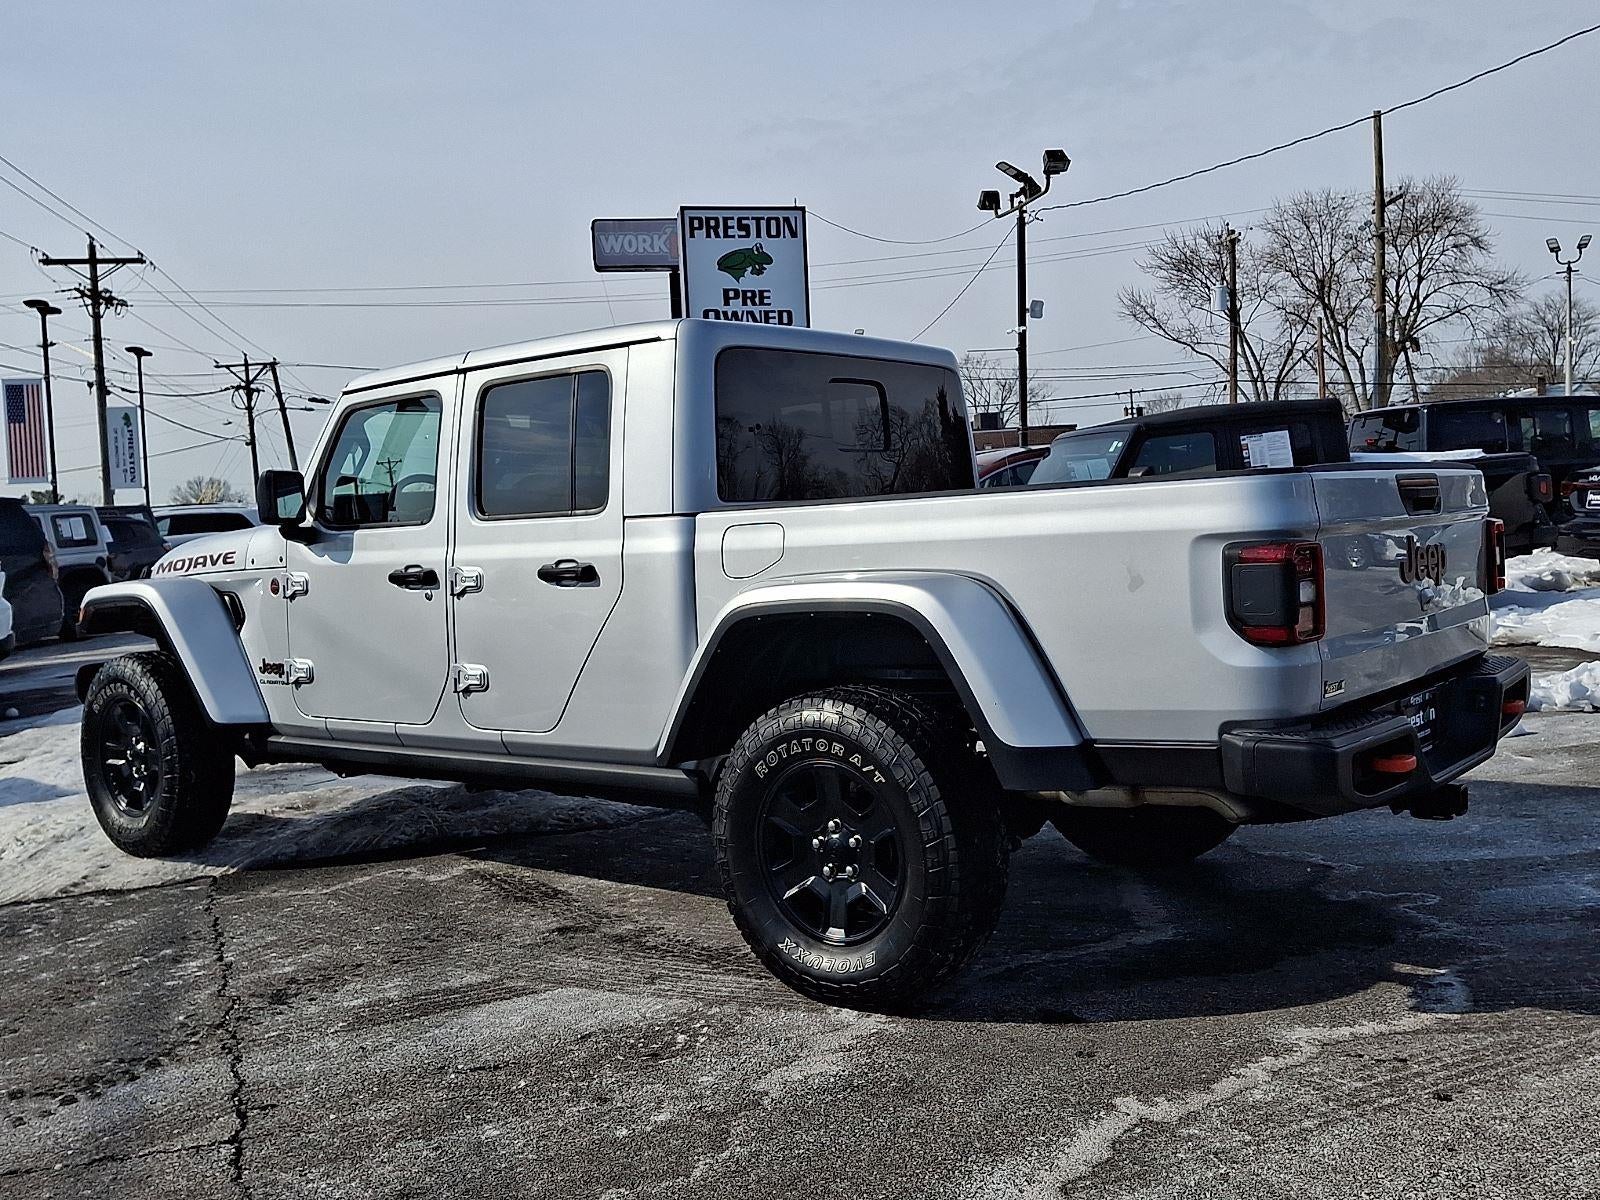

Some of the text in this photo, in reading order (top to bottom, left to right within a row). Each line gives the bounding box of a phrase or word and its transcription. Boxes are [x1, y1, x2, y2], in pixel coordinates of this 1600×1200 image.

[688, 215, 798, 239] PRESTON
[599, 229, 672, 254] WORK
[722, 288, 772, 307] PRE
[702, 308, 794, 327] OWNED
[126, 429, 137, 483] PRESTON
[156, 551, 237, 575] MOJAVE
[1398, 535, 1447, 588] Jeep
[259, 657, 285, 678] Jeep
[754, 737, 886, 783] ROTATOR A/T
[777, 936, 877, 974] EVOLUXX
